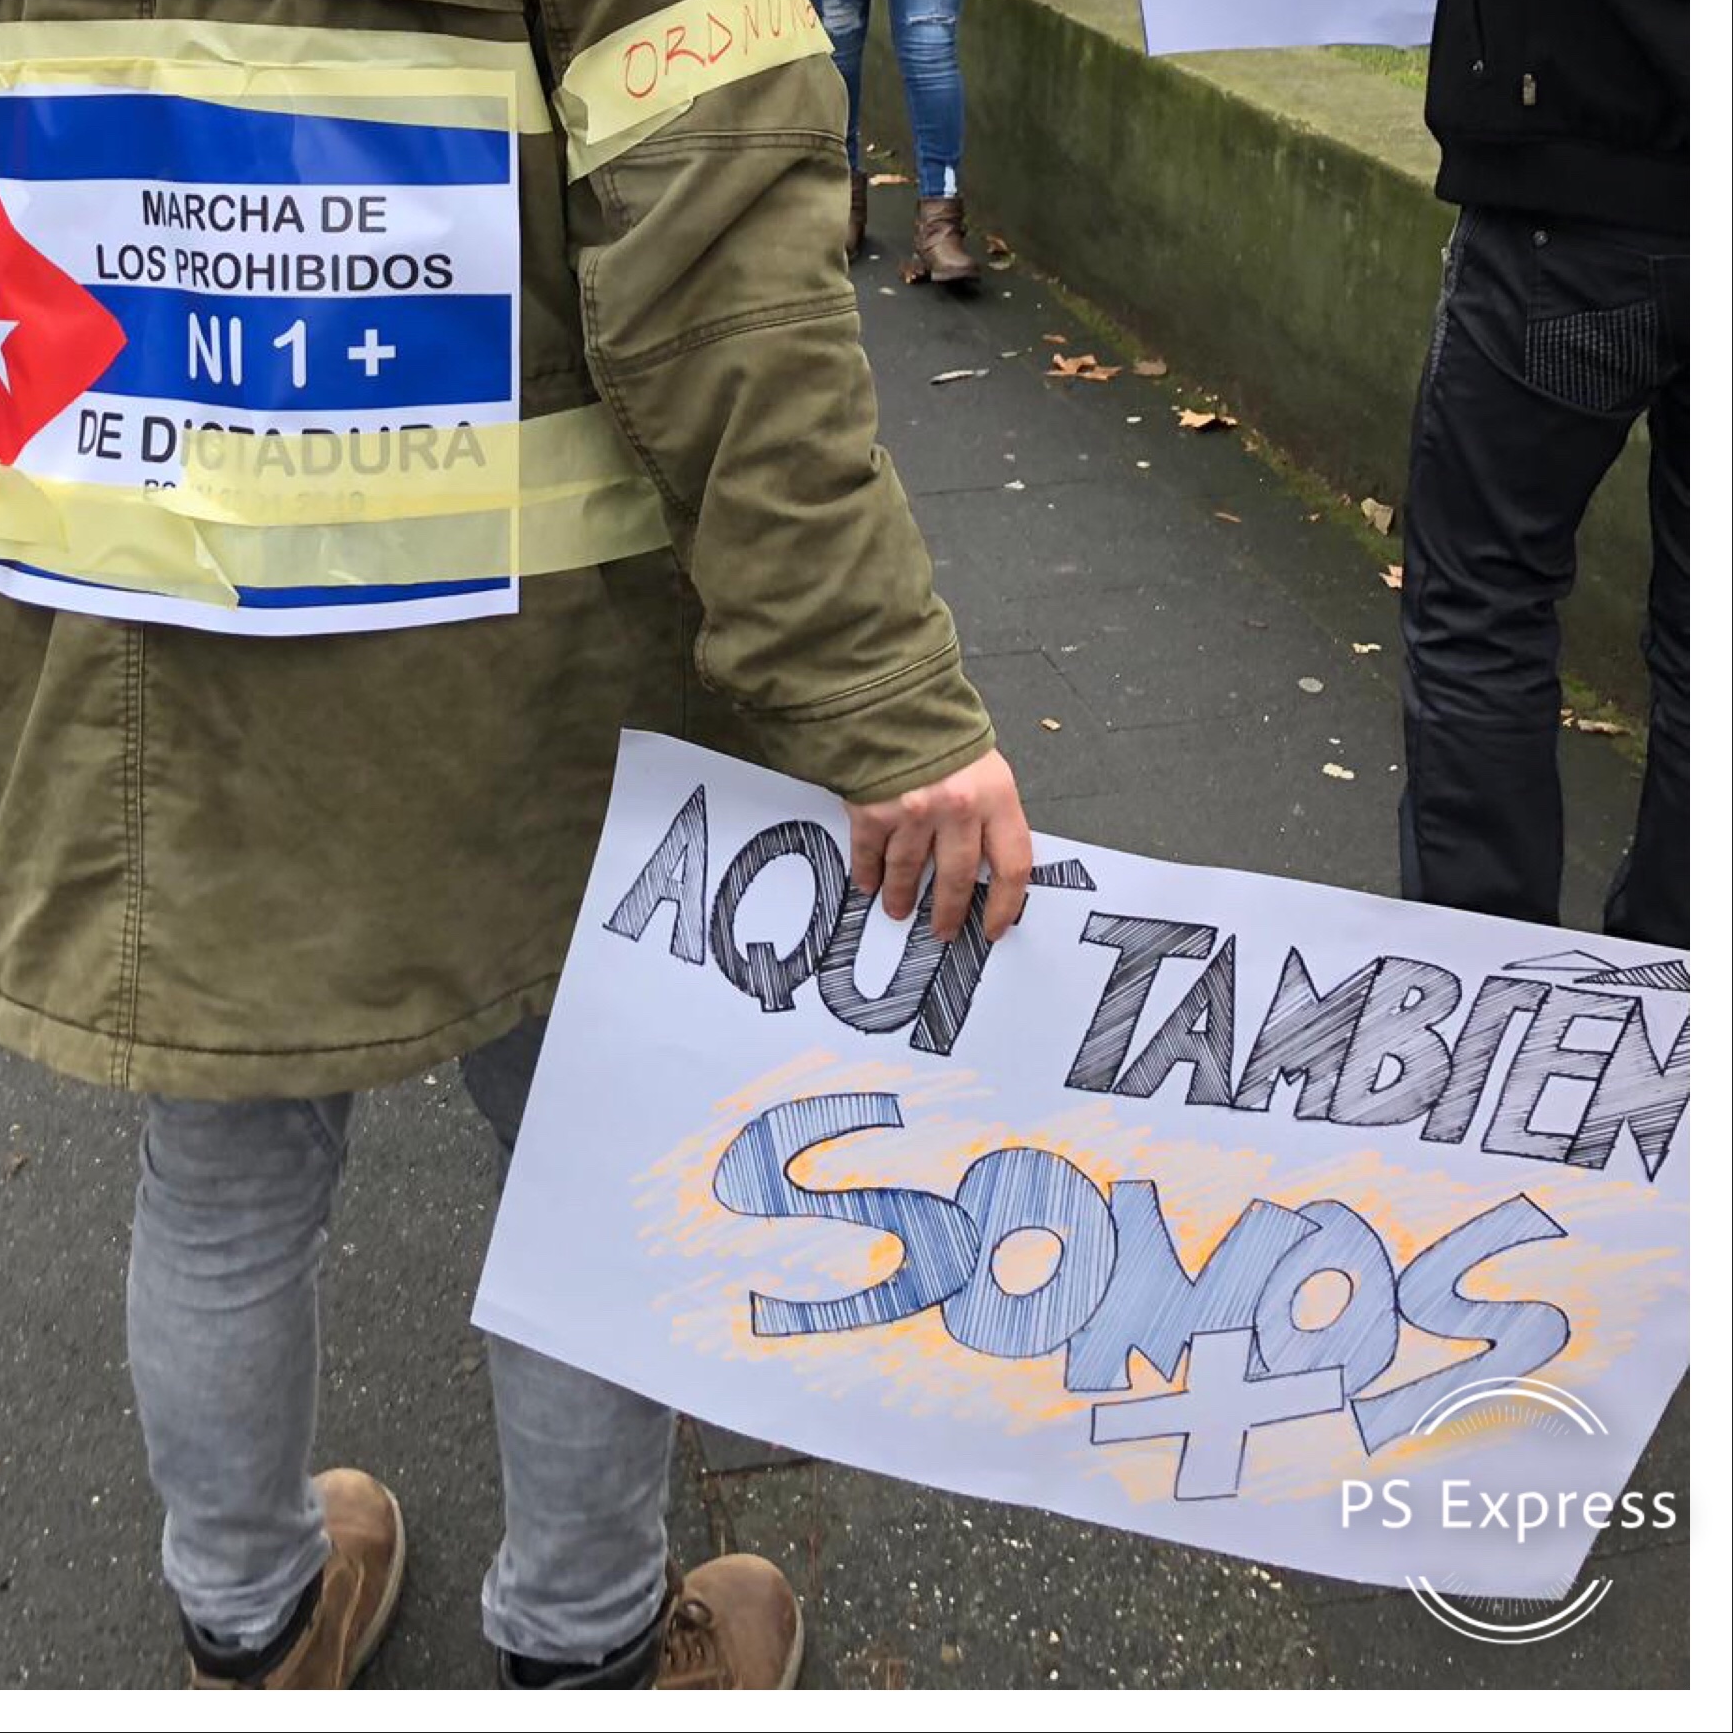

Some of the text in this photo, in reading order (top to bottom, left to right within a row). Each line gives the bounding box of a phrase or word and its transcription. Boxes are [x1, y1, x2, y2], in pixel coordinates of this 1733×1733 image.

[142, 190, 387, 233] MARCHA DE
[96, 244, 453, 292] LOS PROHIBIDOS
[188, 312, 397, 389] NI 1 +
[77, 409, 487, 478] DE DICTADURA
[713, 1093, 1571, 1454] SOMOS
